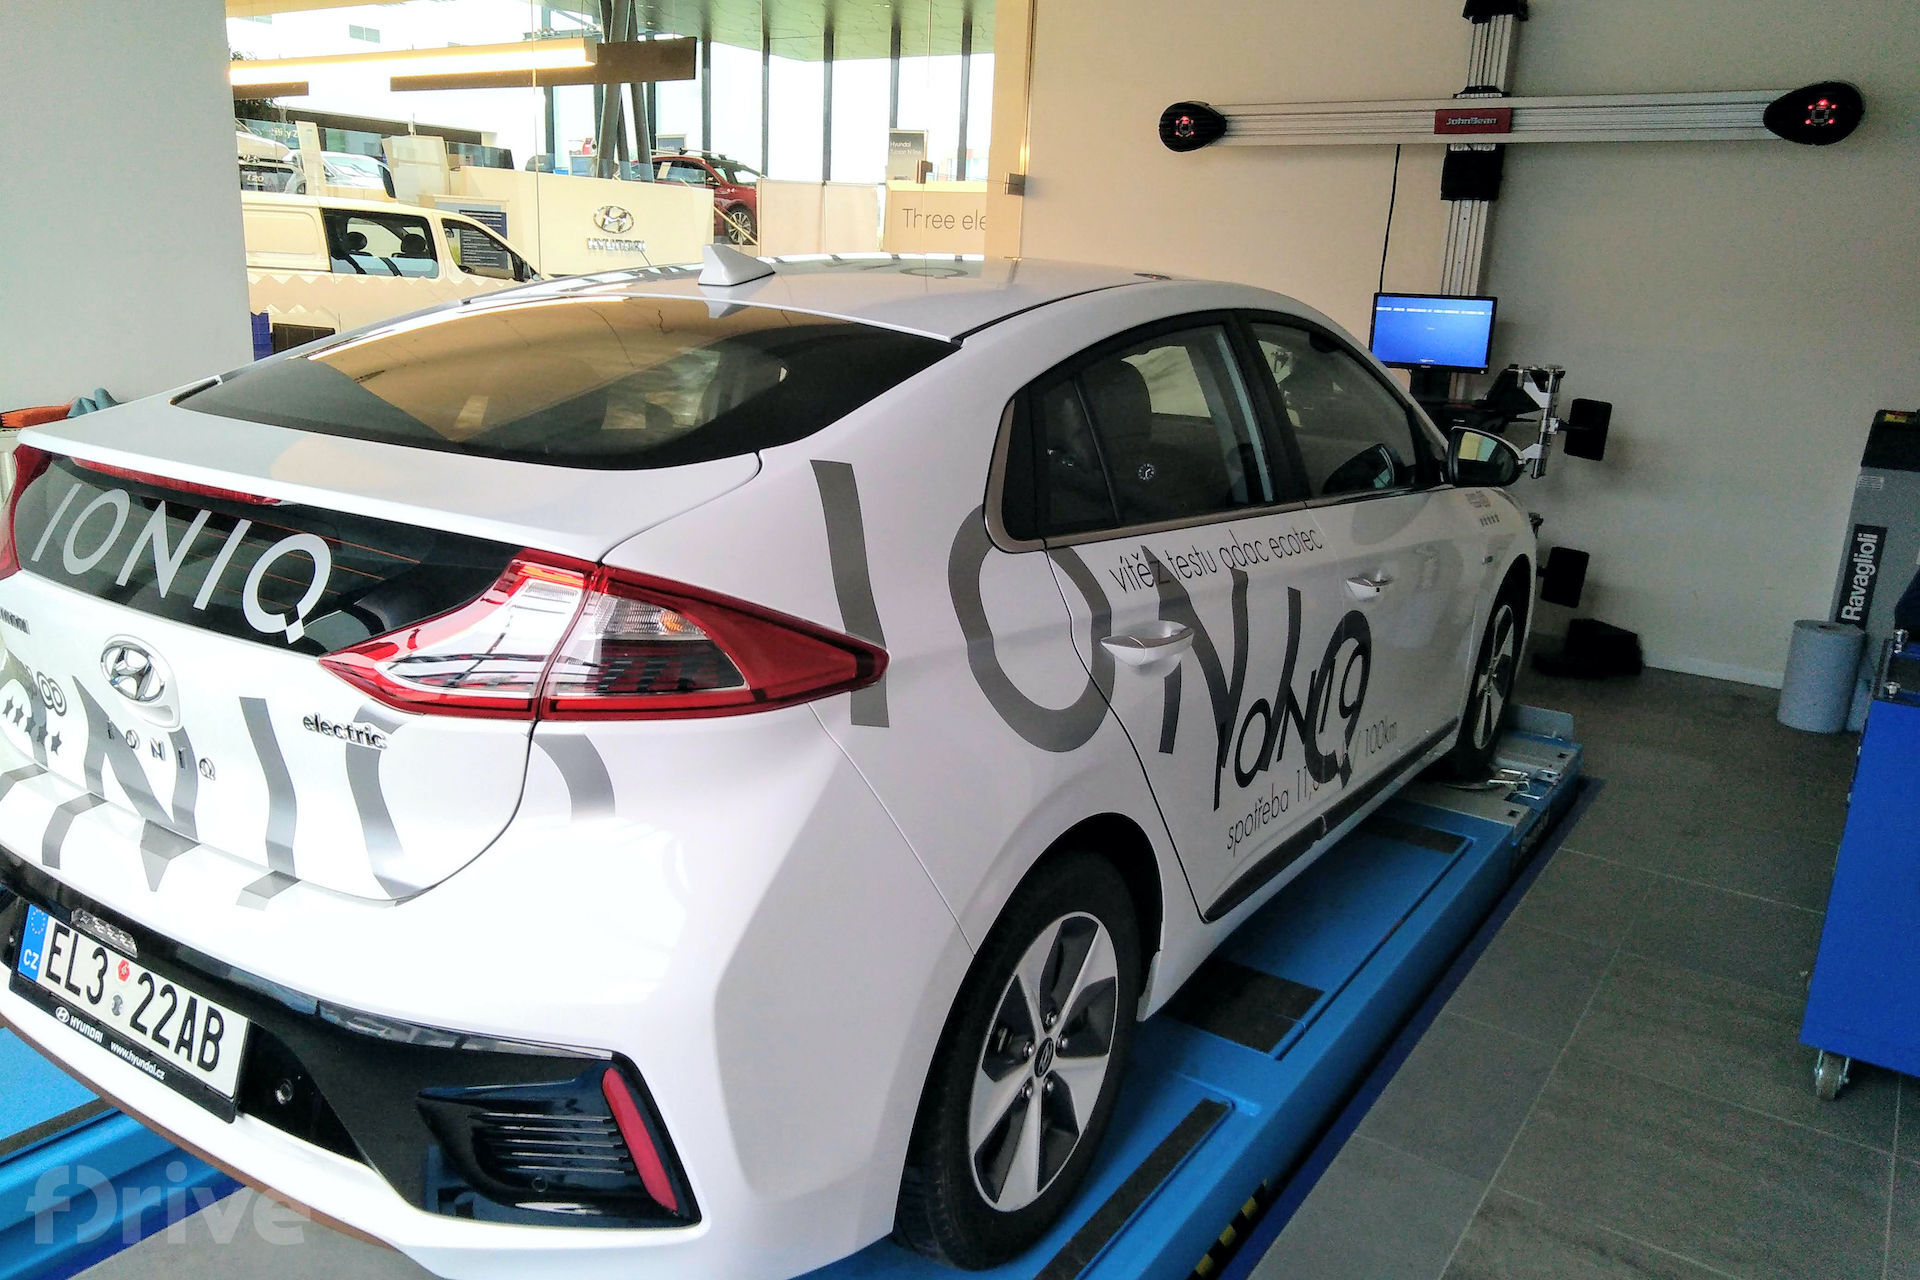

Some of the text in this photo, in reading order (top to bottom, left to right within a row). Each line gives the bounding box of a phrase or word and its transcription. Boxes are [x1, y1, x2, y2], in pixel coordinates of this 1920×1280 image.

[1446, 116, 1497, 126] JohnBean
[902, 208, 955, 230] Three
[30, 483, 332, 644] IONIQ
[1109, 527, 1323, 593] vítěz testu adac ecotec
[1841, 532, 1878, 621] Ravaglioli
[107, 719, 216, 781] IONIQ
[303, 712, 387, 750] electric
[1226, 782, 1289, 857] spotřeba
[24, 948, 39, 971] CZ
[45, 922, 225, 1073] EL3 22AB
[70, 1015, 166, 1081] HYUNDAI www.hyundai.cz
